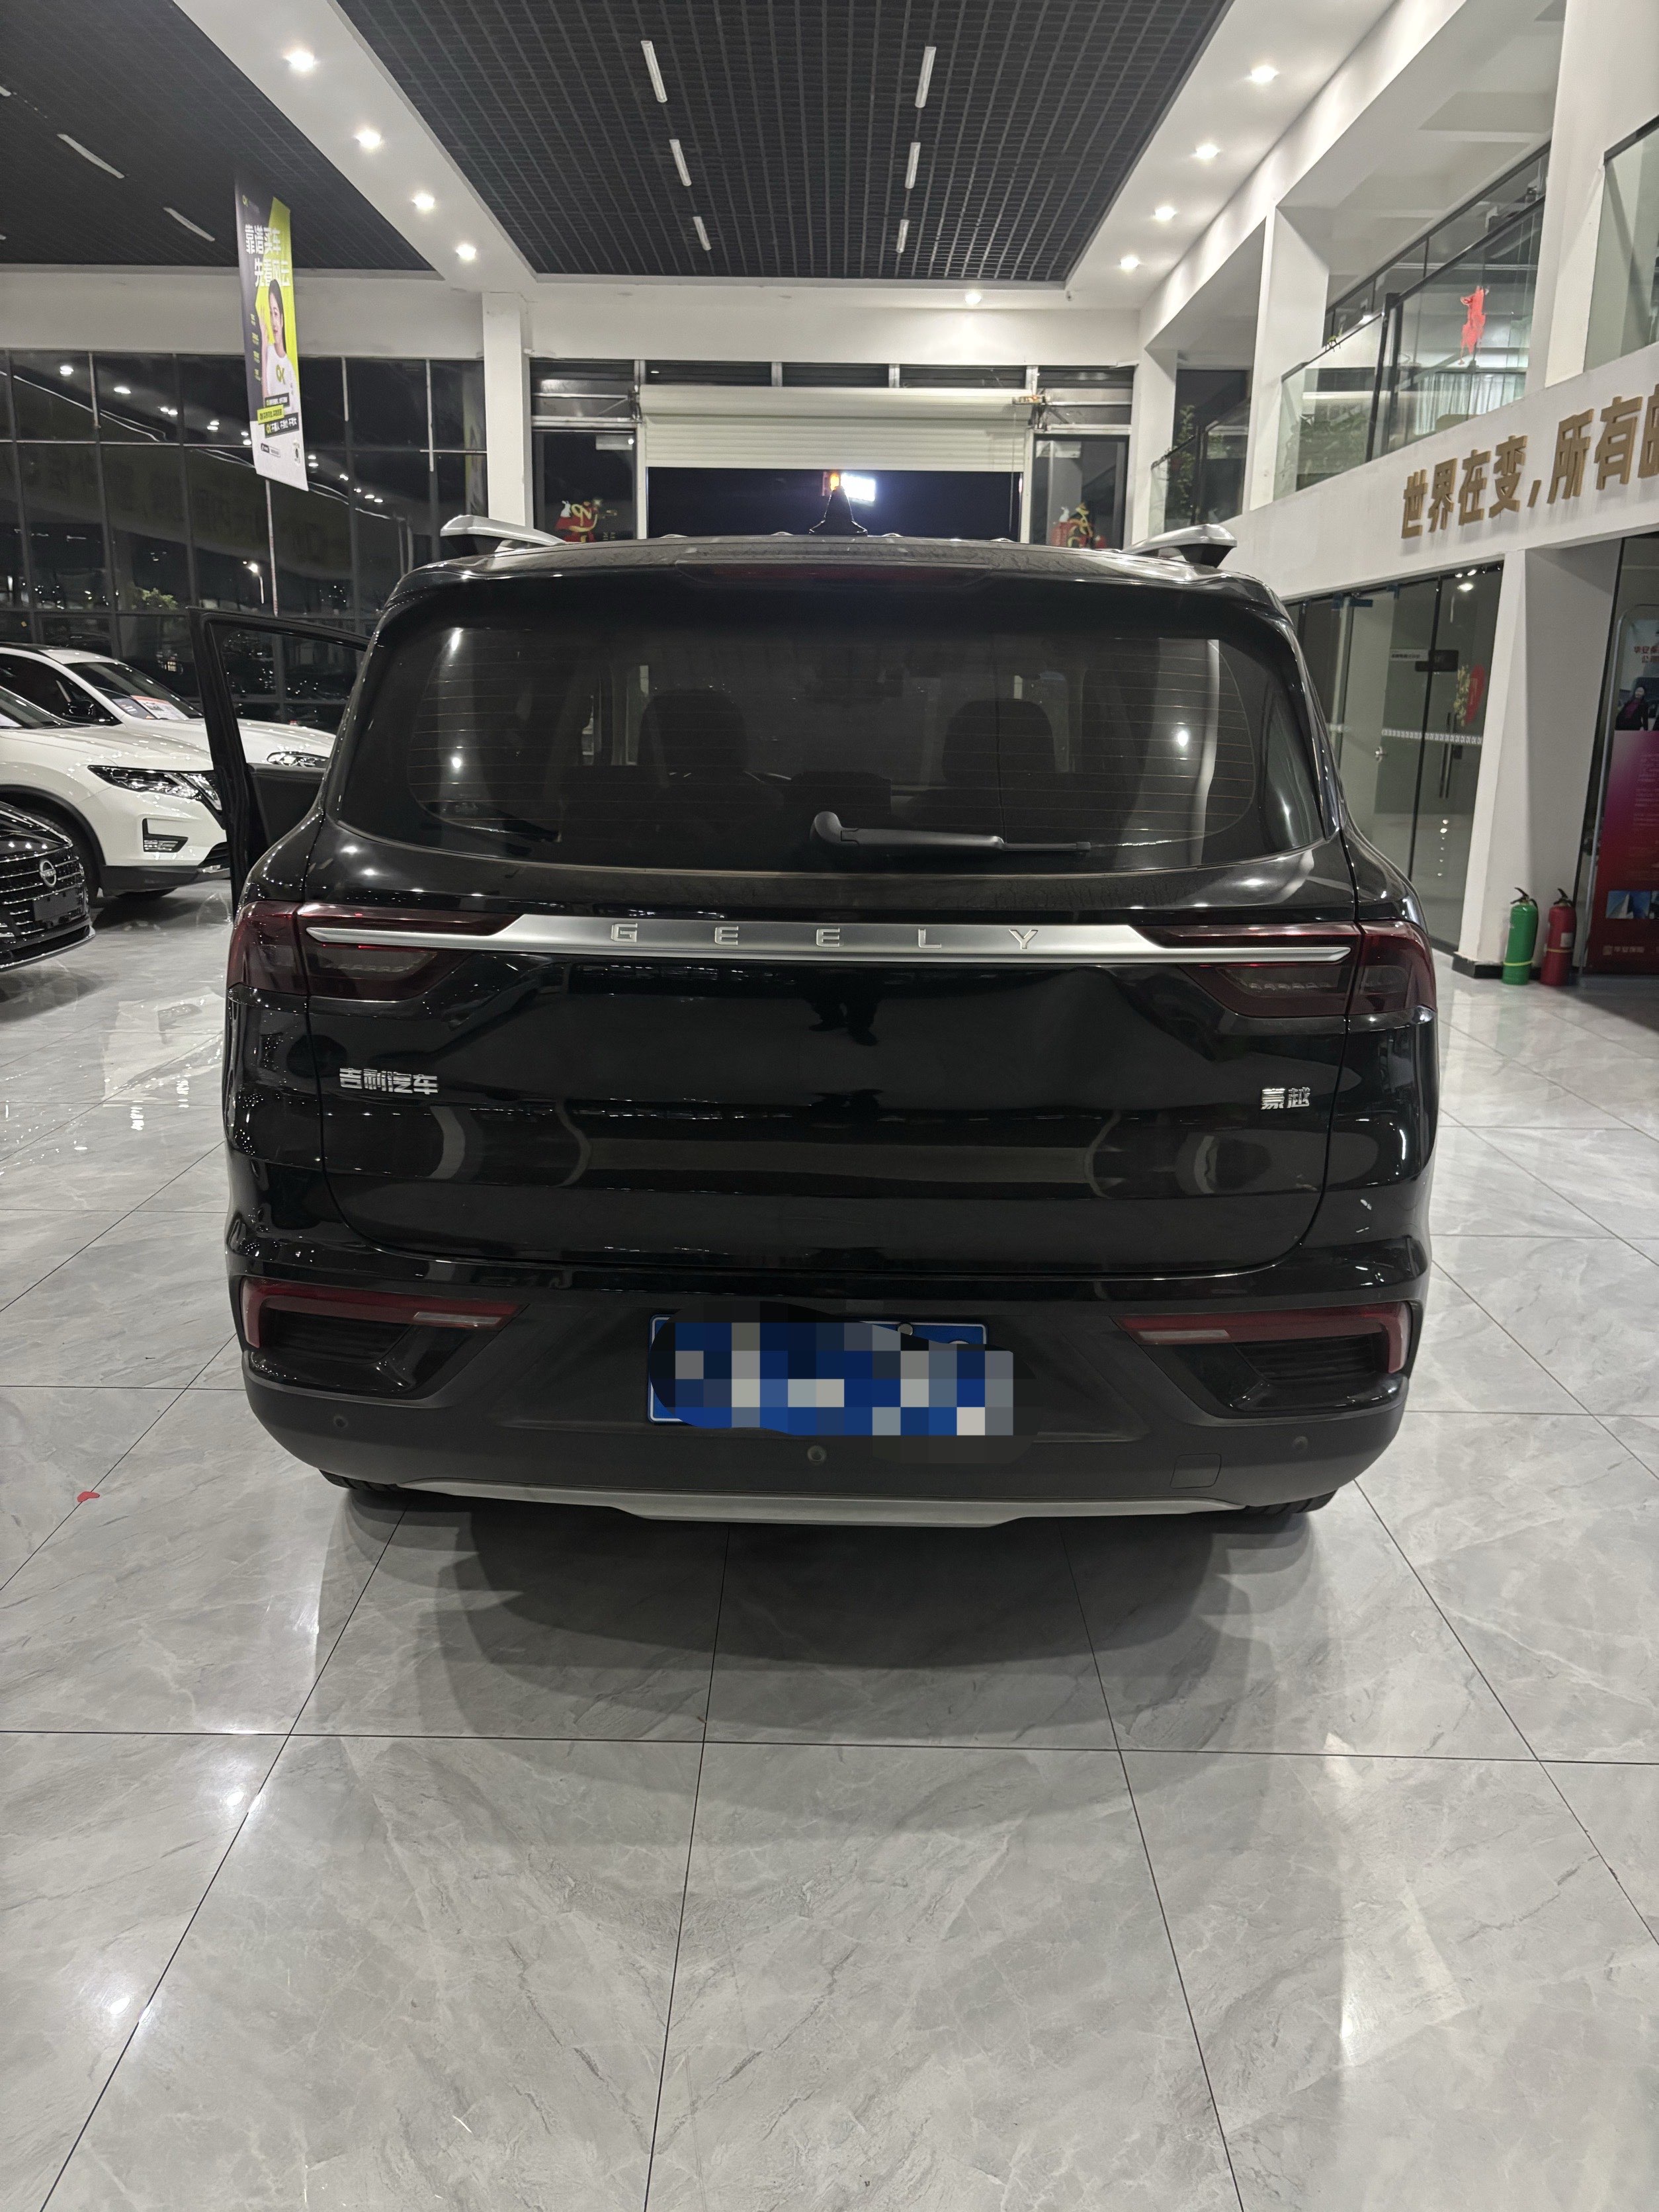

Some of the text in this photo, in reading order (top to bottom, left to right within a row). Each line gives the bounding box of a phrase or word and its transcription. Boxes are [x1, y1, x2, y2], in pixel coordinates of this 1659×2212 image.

[611, 923, 1038, 949] GEELY
[339, 1068, 438, 1095] 吉利汽车
